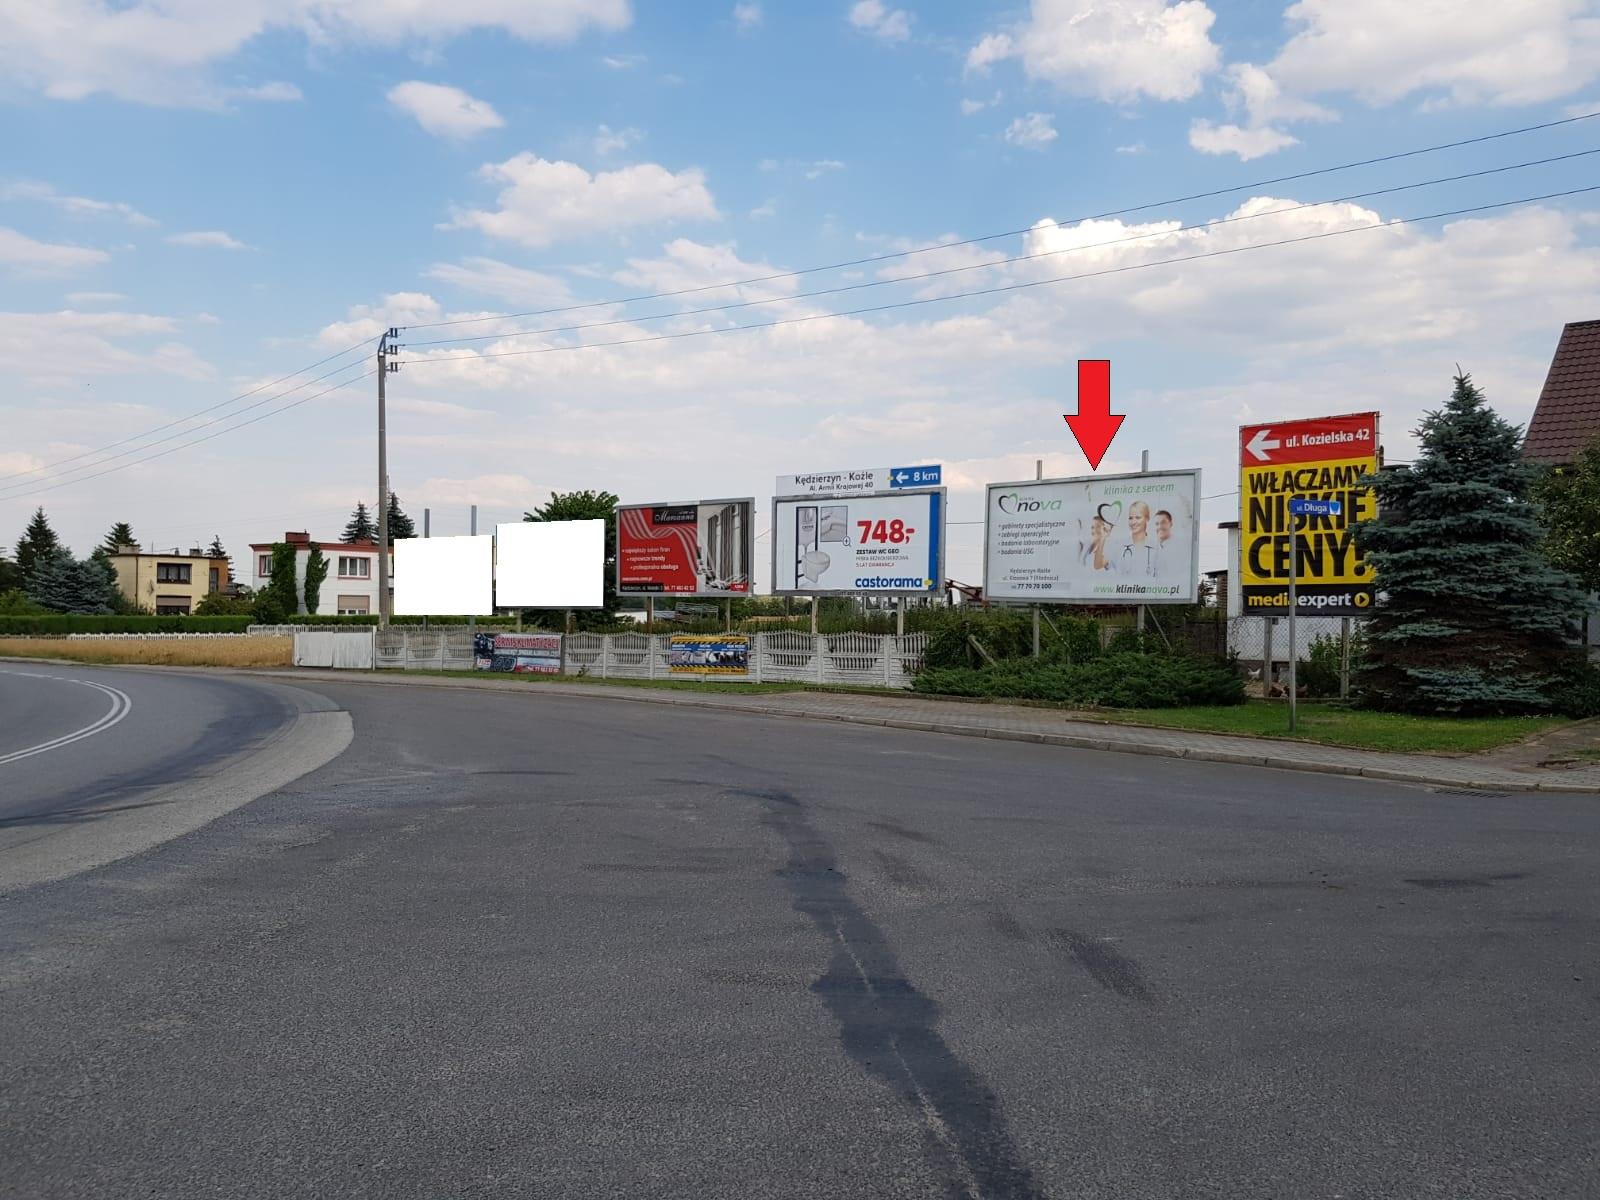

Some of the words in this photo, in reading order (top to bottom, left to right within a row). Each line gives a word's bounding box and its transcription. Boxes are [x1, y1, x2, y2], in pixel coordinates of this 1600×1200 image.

[1285, 436, 1300, 448] ul.
[1302, 431, 1354, 446] Kozielska
[1356, 428, 1370, 441] 42
[795, 474, 841, 486] Kędzierzyn
[849, 472, 874, 481] Koźle
[913, 472, 920, 481] 8
[922, 471, 939, 481] km
[1248, 464, 1368, 494] WŁĄCZAMY
[836, 482, 864, 490] Krajowej
[1104, 485, 1134, 496] klinika
[1135, 486, 1141, 494] z
[1142, 483, 1175, 493] sercem
[1016, 499, 1062, 512] nova
[1304, 503, 1328, 513] Długa
[857, 519, 915, 544] 748,-
[1248, 533, 1367, 579] CENY!
[855, 575, 923, 588] castorama
[1248, 592, 1351, 609] mediexpert
